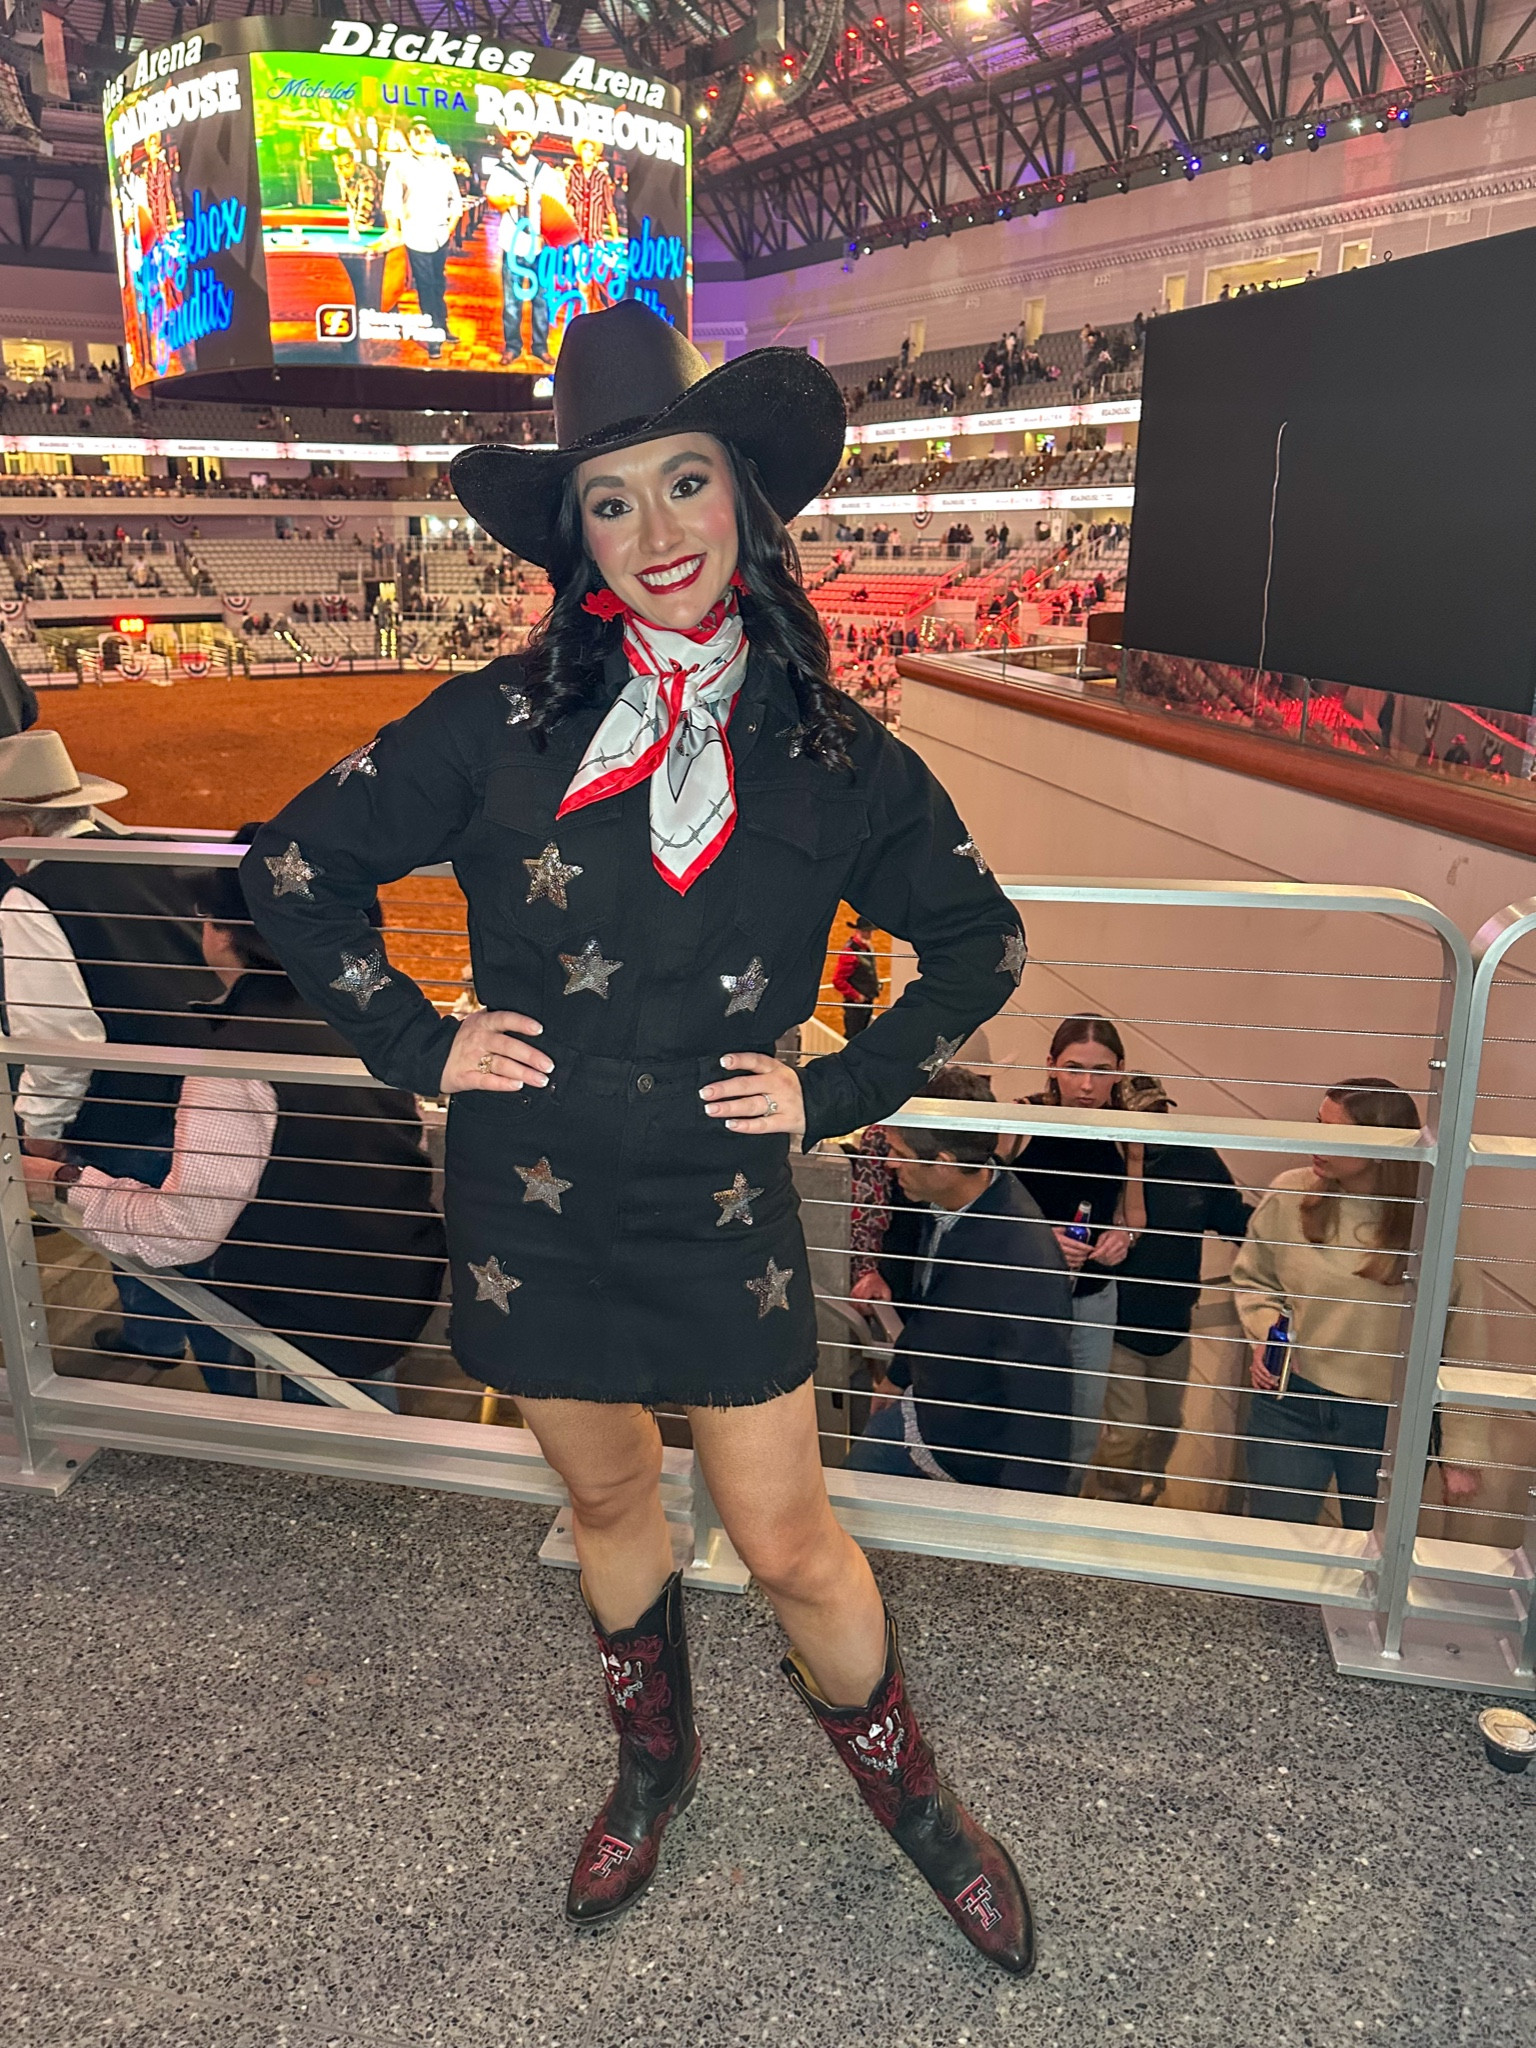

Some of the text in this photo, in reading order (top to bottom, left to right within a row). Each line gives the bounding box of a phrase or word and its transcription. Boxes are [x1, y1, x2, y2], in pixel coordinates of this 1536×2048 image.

[133, 35, 203, 91] Arena
[267, 78, 470, 112] Michelob ULTRA
[320, 20, 666, 109] Dickies Arena
[507, 216, 685, 301] Squeezebox
